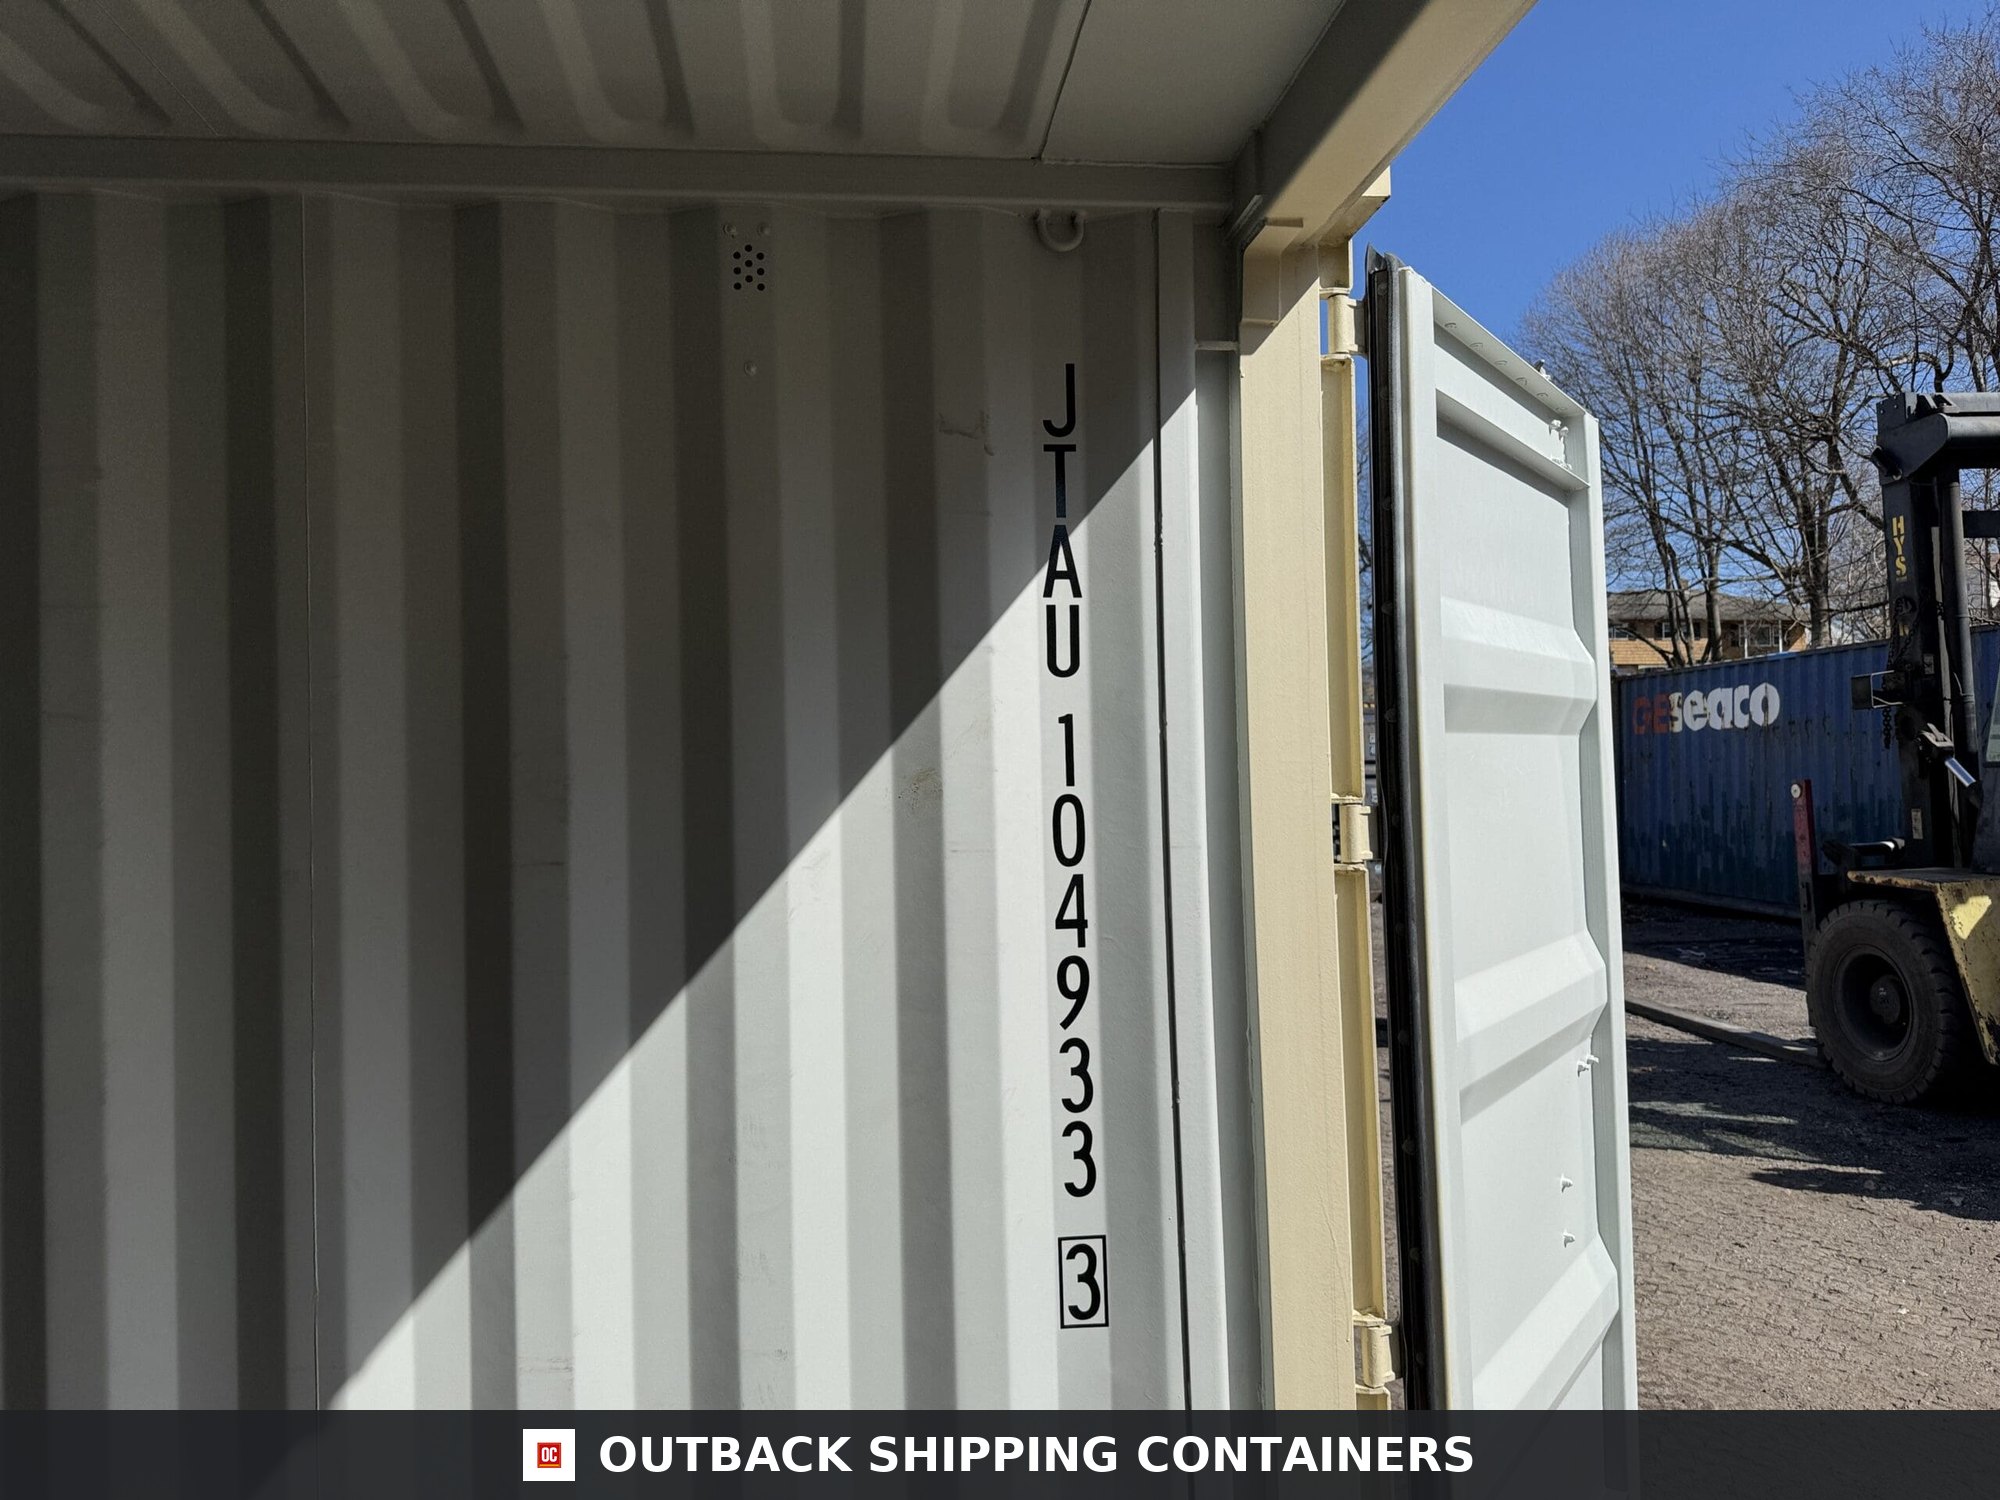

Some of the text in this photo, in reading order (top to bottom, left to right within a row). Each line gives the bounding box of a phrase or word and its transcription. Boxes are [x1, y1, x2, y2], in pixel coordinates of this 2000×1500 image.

[1042, 362, 1104, 1324] JTAU 104933 3
